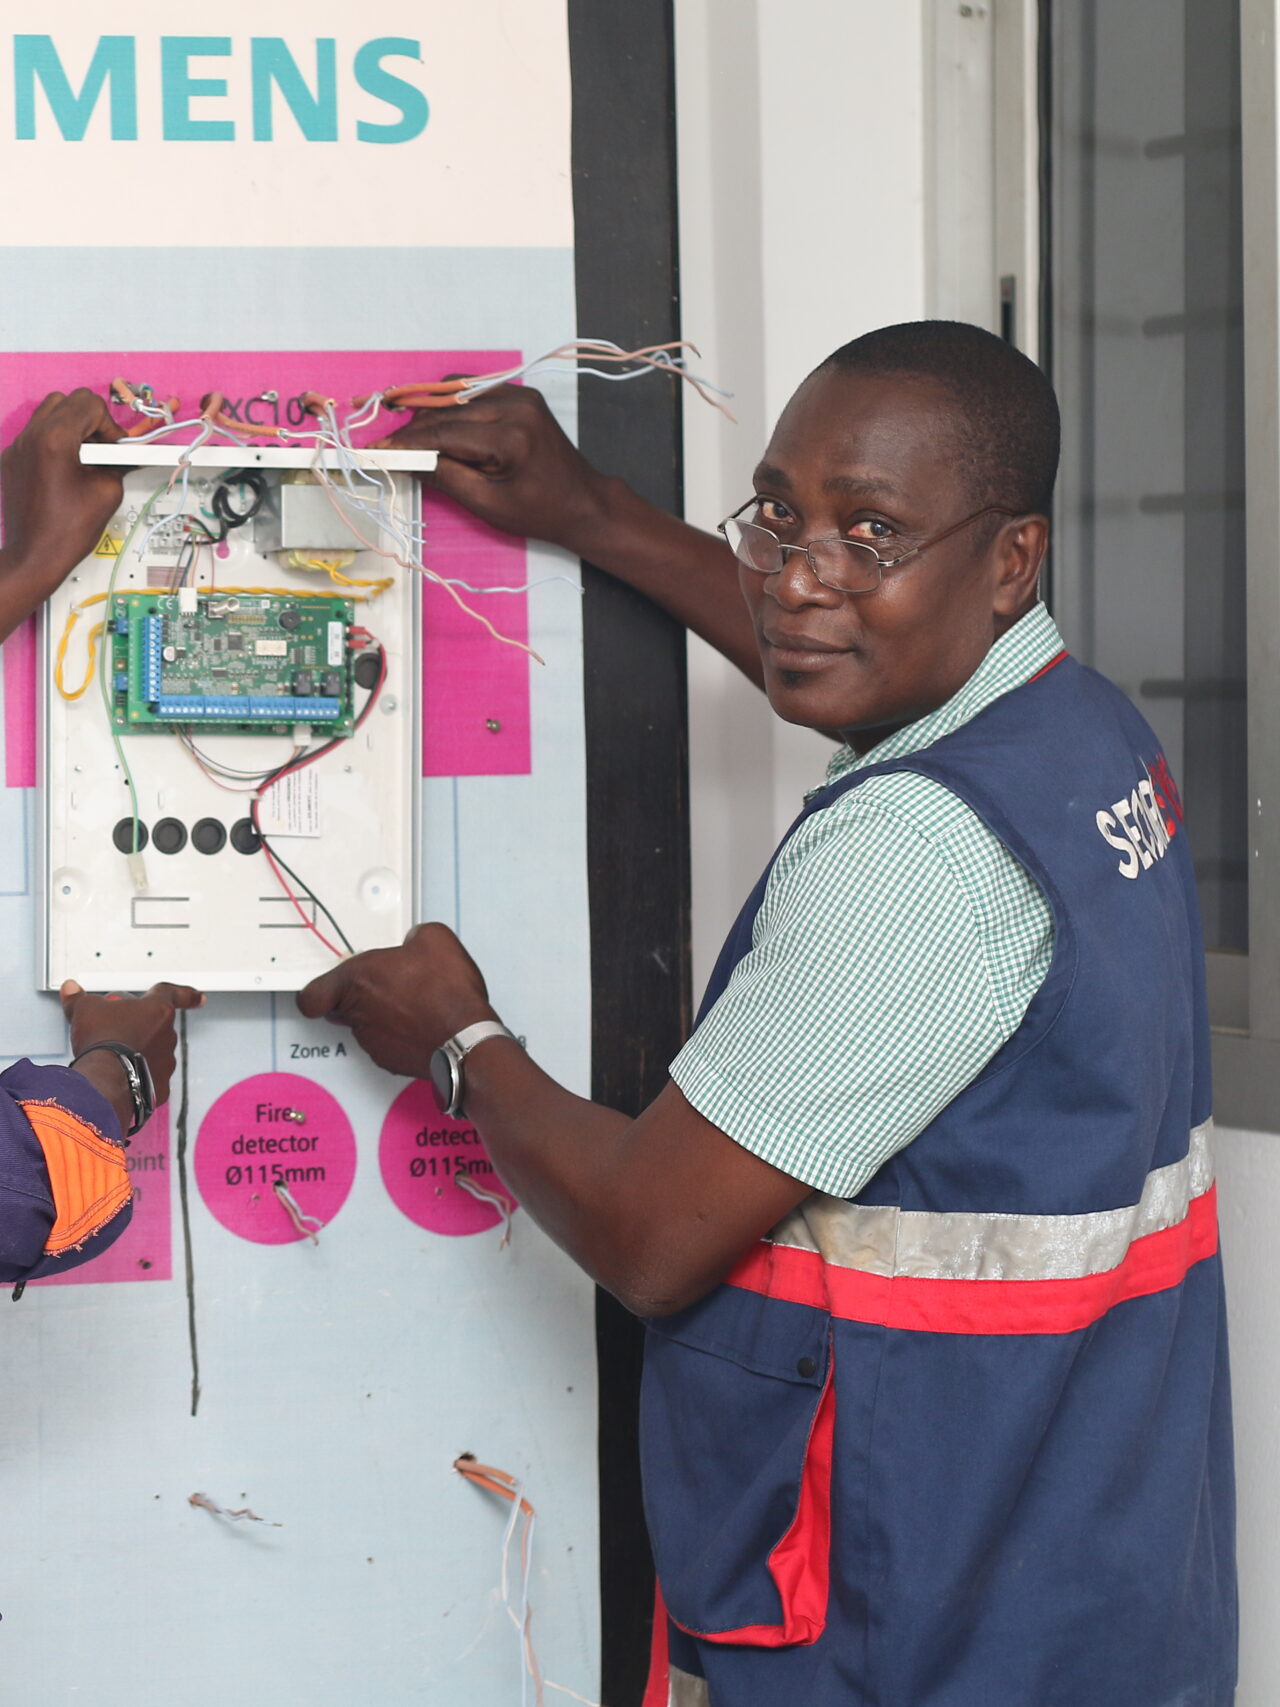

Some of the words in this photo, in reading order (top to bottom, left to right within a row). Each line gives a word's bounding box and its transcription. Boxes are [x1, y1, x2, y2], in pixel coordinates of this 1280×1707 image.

[290, 1043, 331, 1059] Zone
[335, 1042, 347, 1057] A
[256, 1103, 295, 1123] Fire
[231, 1134, 319, 1155] detector
[225, 1164, 326, 1186] Ø115mm
[410, 1156, 494, 1177] Ø115m
